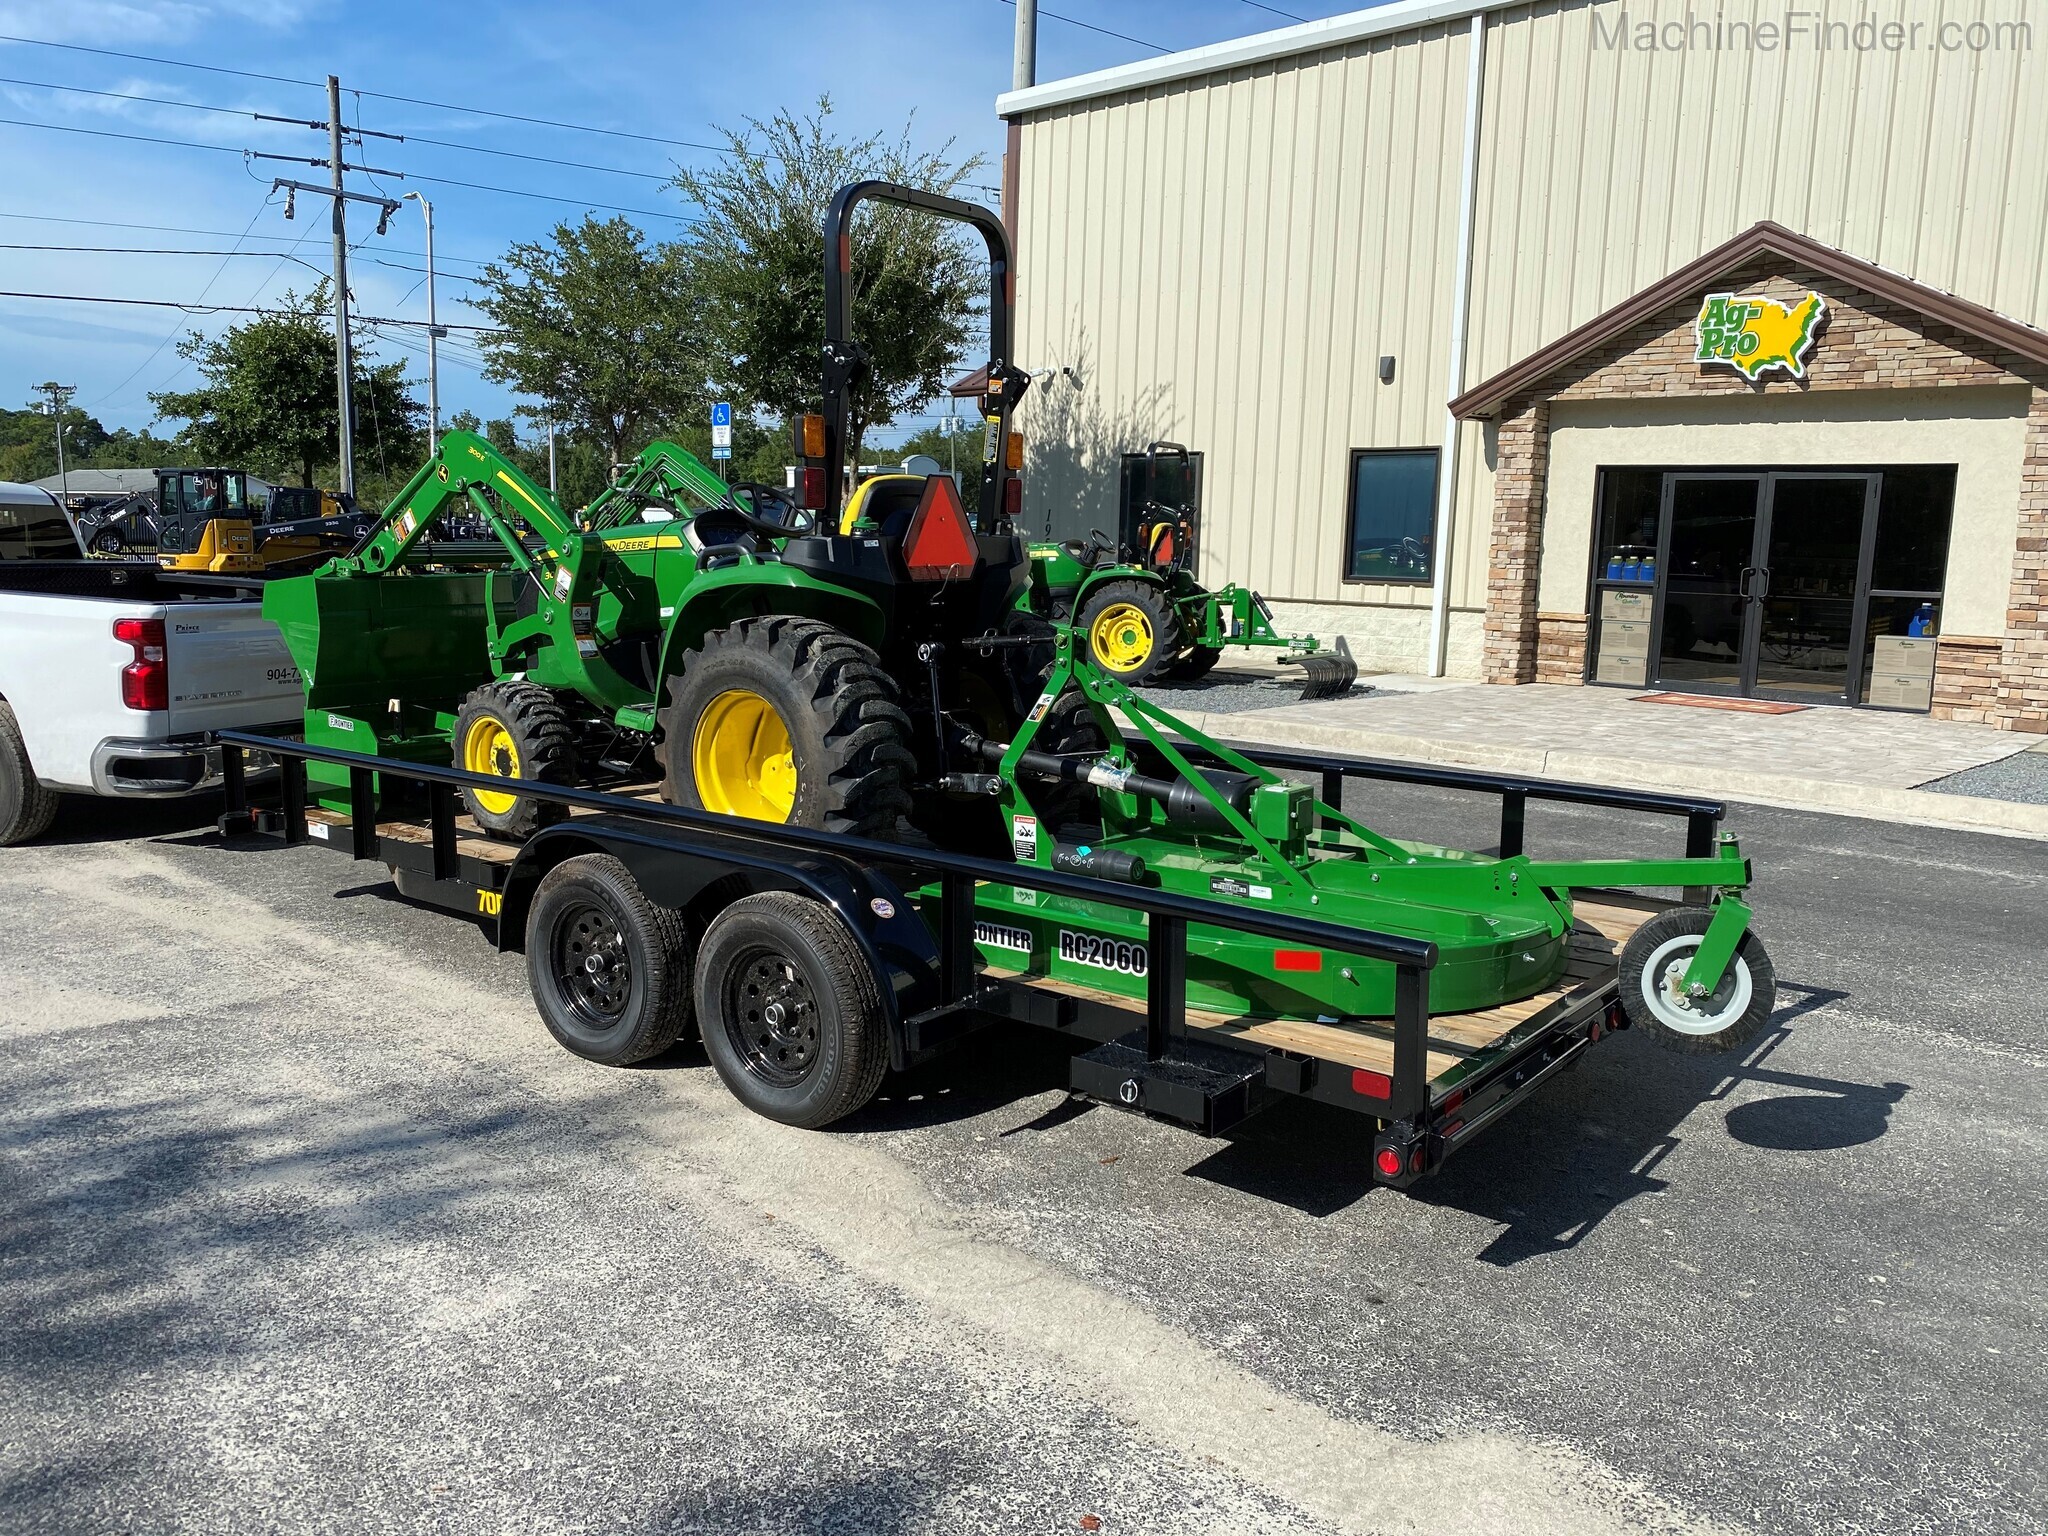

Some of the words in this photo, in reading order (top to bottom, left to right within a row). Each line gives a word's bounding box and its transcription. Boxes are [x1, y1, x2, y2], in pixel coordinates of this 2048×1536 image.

[1701, 296, 1762, 333] Ag-
[1697, 327, 1760, 360] Pro
[110, 508, 127, 522] DEERE
[269, 525, 295, 535] DEERE
[619, 540, 650, 550] DEERE
[1061, 931, 1147, 975] RC2060
